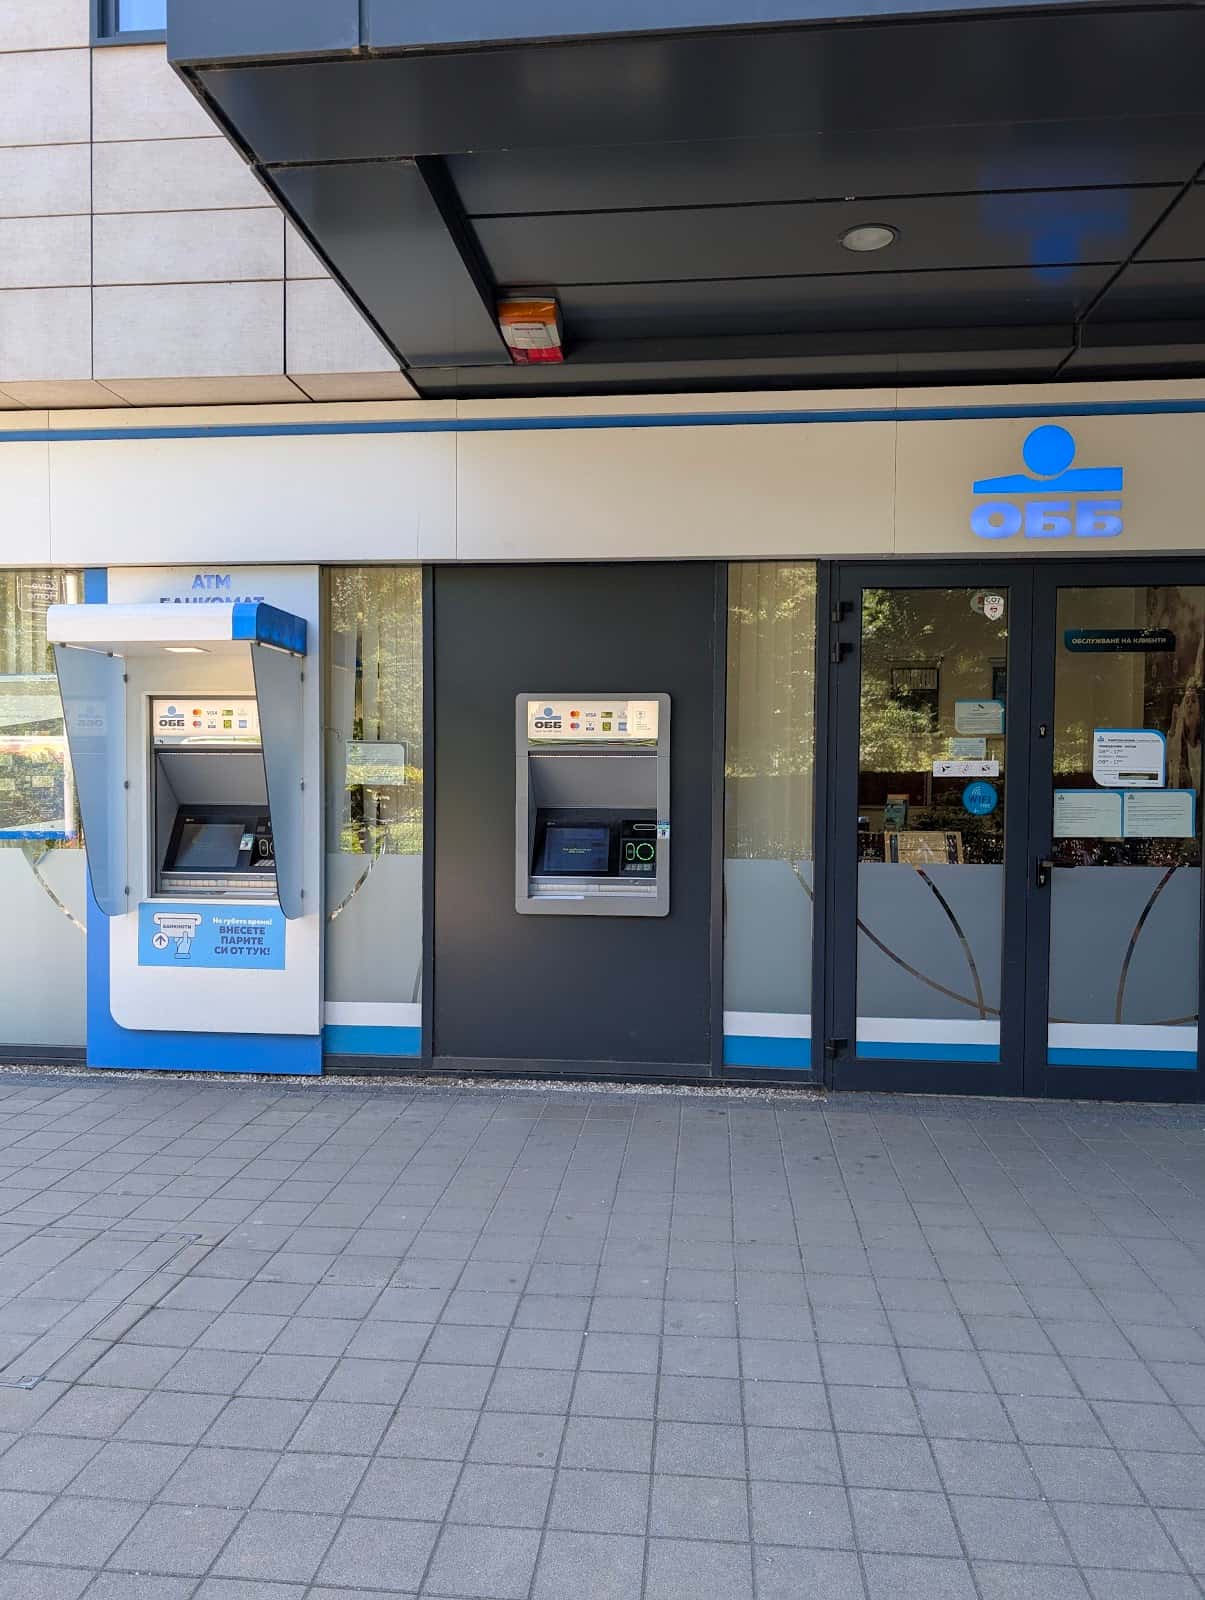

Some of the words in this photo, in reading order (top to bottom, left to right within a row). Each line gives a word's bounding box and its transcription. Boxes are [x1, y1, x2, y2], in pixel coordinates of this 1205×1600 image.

[970, 500, 1123, 539] ОББ
[159, 719, 185, 727] ОББ
[534, 721, 562, 729] ОББ
[219, 926, 266, 935] ВНЕСЕТЕ
[221, 936, 264, 945] ПАРИТЕ
[214, 946, 230, 954] СИ
[230, 947, 245, 955] ОТ
[246, 947, 271, 956] ТУК!
